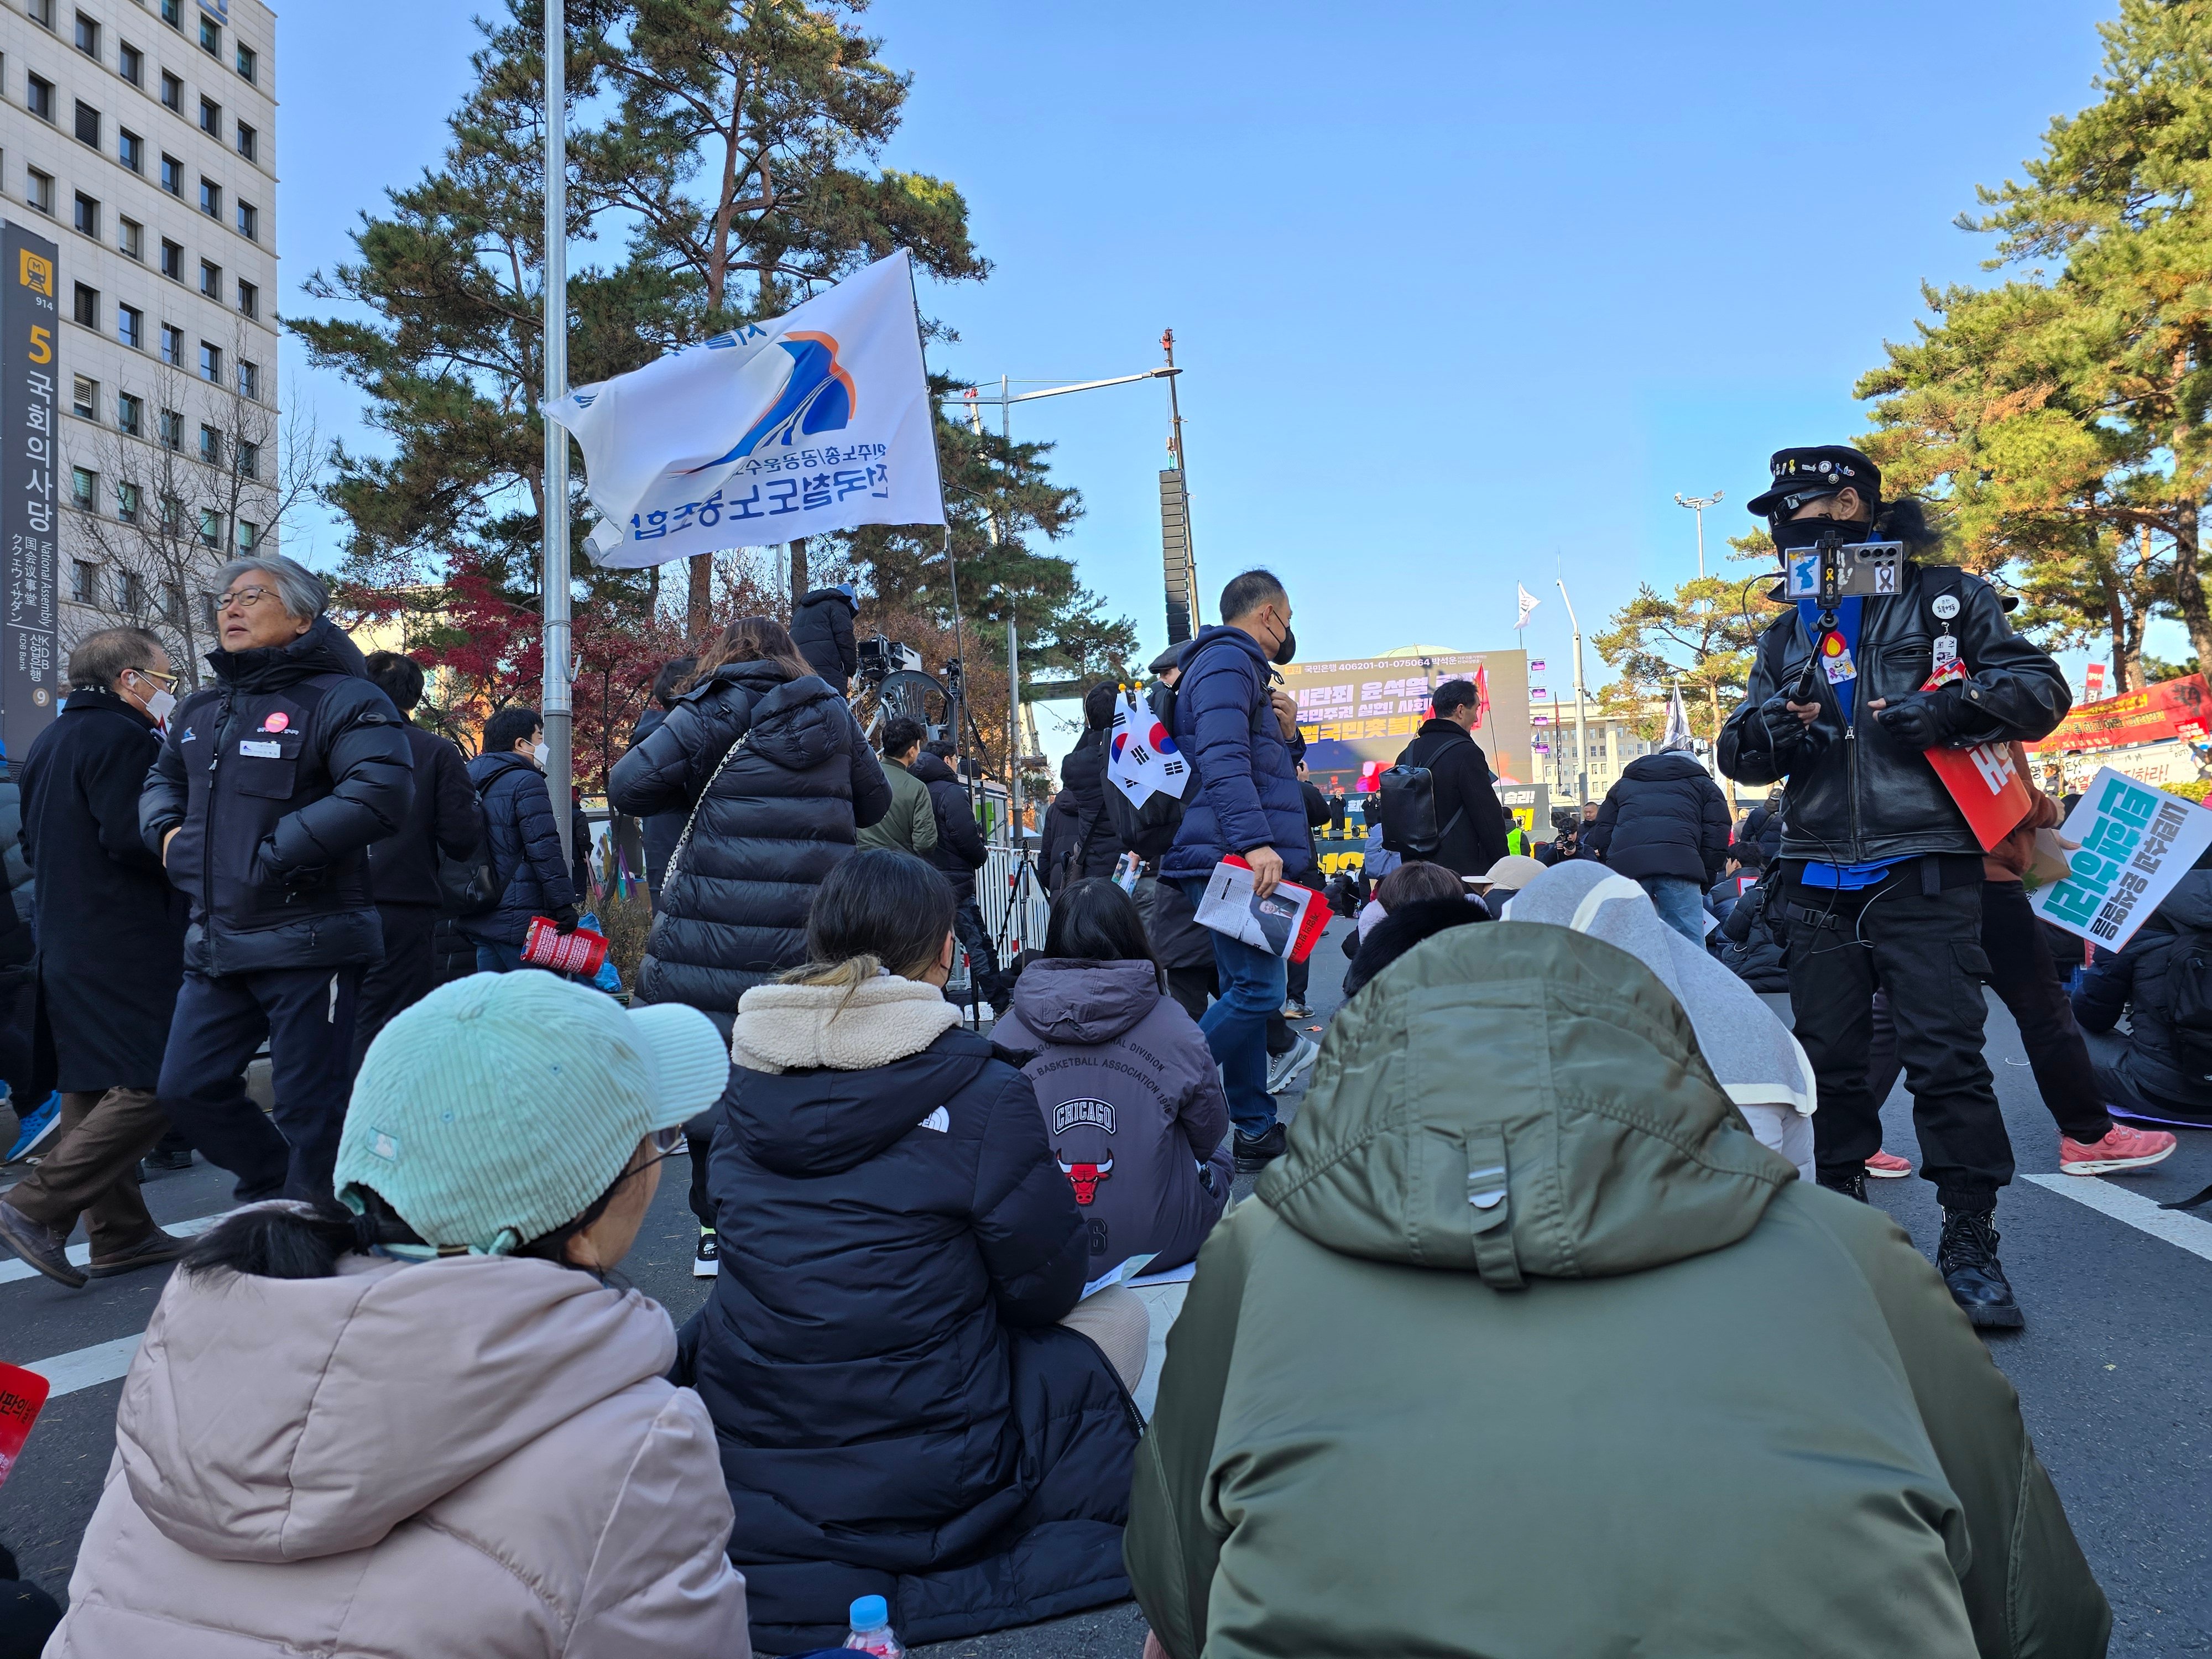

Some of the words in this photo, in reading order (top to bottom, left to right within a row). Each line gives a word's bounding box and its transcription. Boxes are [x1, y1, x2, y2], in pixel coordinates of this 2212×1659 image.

[36, 296, 53, 311] 914
[28, 325, 52, 364] 5
[25, 370, 54, 533] 국회의사당
[24, 536, 37, 607] 国会议事堂
[40, 541, 53, 581] National
[38, 581, 53, 628] Assembly
[30, 634, 41, 682] 산업은행
[41, 635, 50, 670] KDB
[1304, 663, 1337, 673] 국민은행
[1339, 658, 1430, 671] 406201-01-075064
[1431, 656, 1457, 666] 박석운
[37, 691, 45, 704] 9
[1288, 685, 1354, 707] 내란죄
[1361, 676, 1428, 702] 윤석열
[1296, 705, 1354, 723] 국민주권
[1358, 701, 1393, 717] 실현!
[1398, 697, 1432, 713] 사회
[1504, 791, 1535, 805] 승리!
[2042, 777, 2159, 927] 탄핵하라
[2131, 801, 2189, 875] 내란수괴
[2089, 871, 2148, 941] 윤석열을
[1129, 1043, 1165, 1072] DIVISION
[1036, 1057, 1099, 1077] BASKETBALL
[1102, 1058, 1160, 1093] ASSOCIATION
[1156, 1093, 1172, 1114] 1946
[1056, 1101, 1112, 1129] CHICAGO
[0, 1390, 28, 1421] 판의
